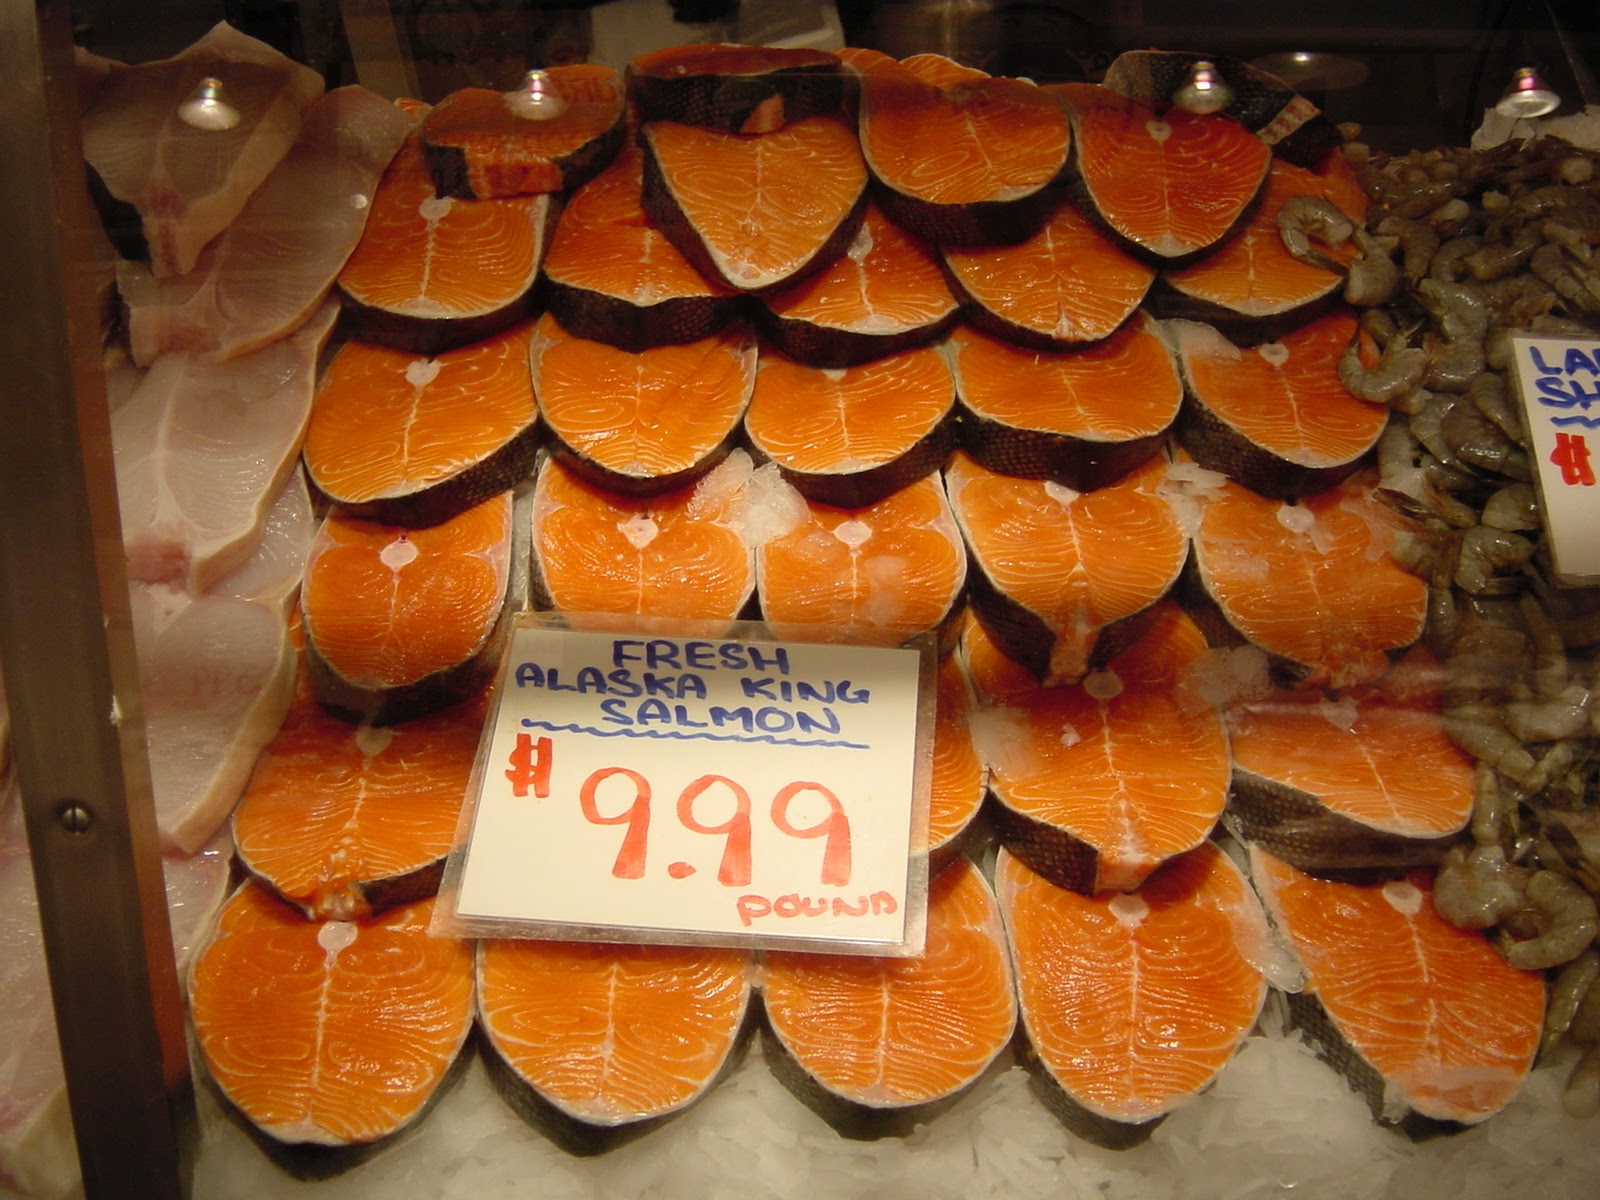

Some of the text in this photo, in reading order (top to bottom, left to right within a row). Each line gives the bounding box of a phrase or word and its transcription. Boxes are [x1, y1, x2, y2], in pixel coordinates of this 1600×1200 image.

[1529, 345, 1600, 377] LA
[612, 639, 789, 674] FRESH
[515, 662, 870, 704] ALASKA KING
[600, 698, 841, 735] SALMON
[736, 890, 898, 926] POUND
